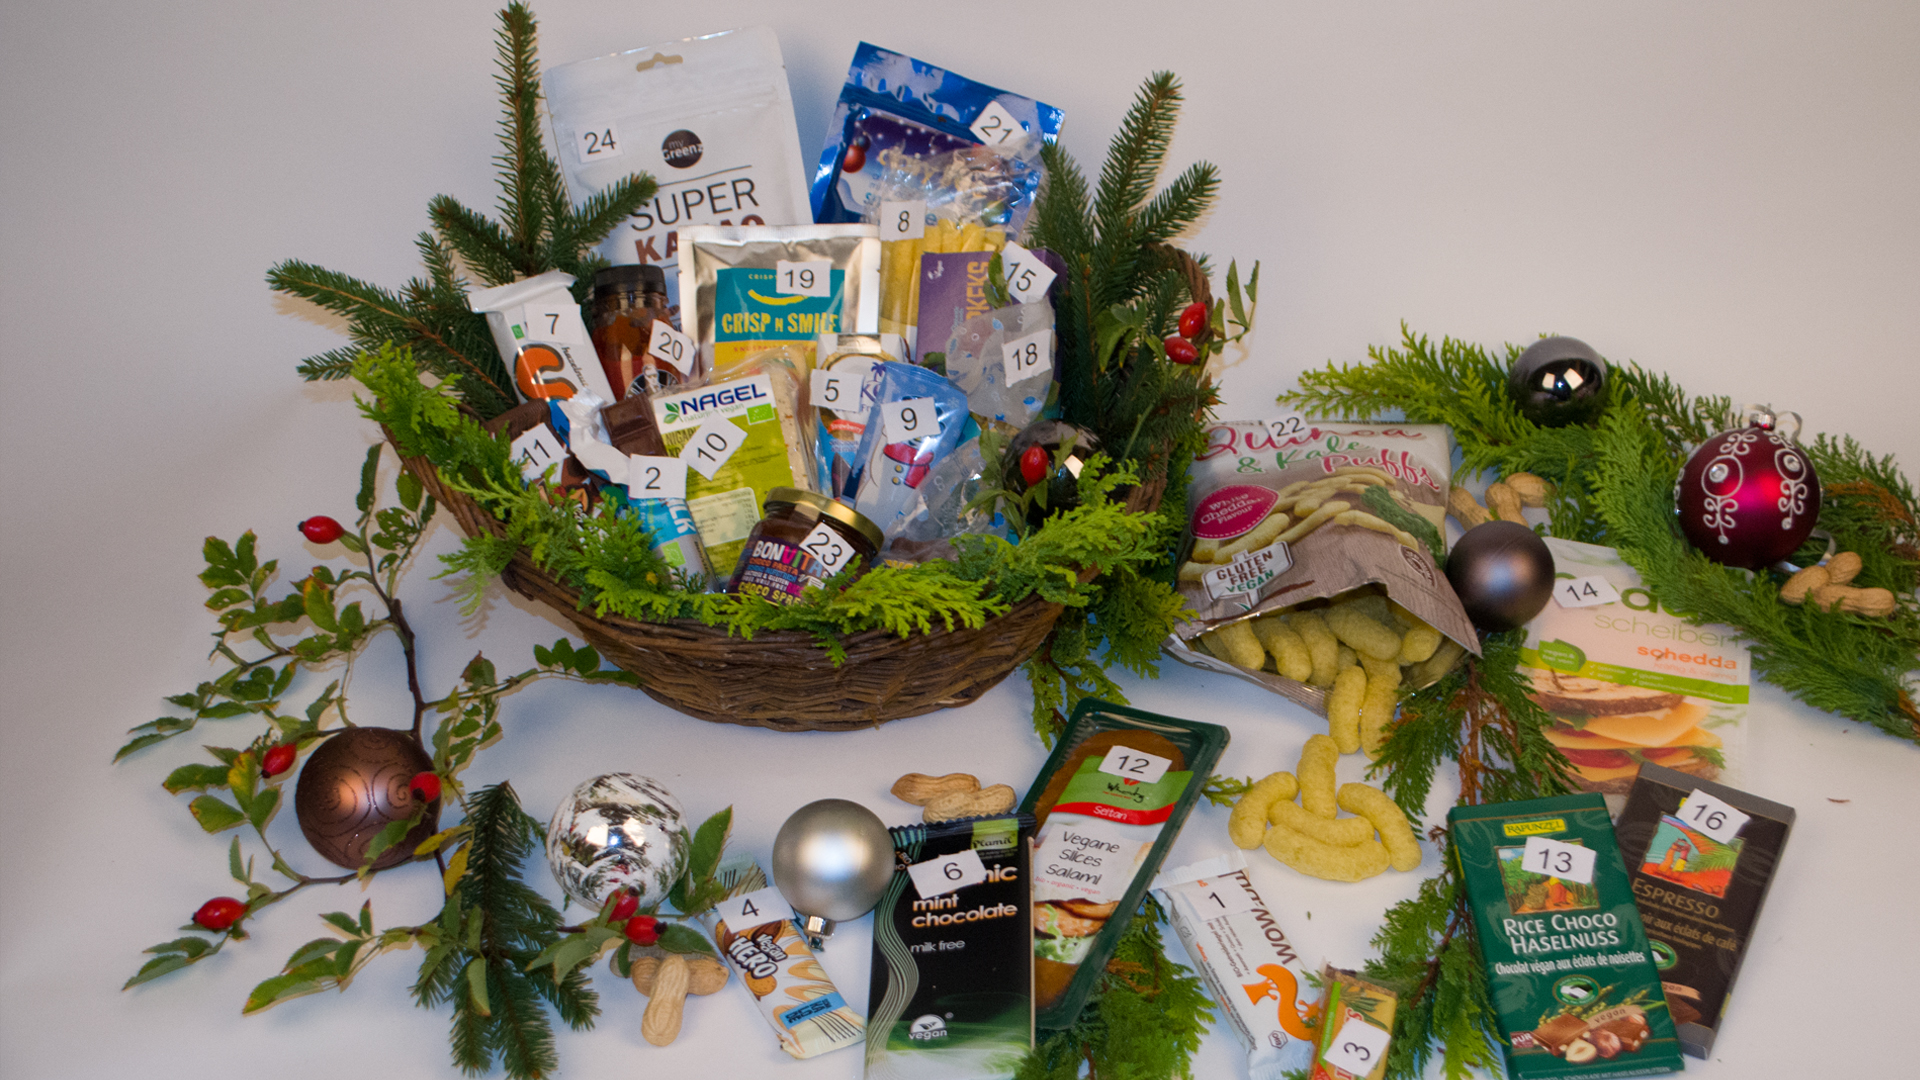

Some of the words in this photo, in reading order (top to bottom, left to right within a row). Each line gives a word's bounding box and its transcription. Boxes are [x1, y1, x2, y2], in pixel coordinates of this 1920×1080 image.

[584, 128, 616, 154] 24
[981, 115, 1013, 144] 21
[631, 177, 759, 231] SUPER
[898, 210, 910, 233] 8
[784, 269, 815, 289] 19
[1007, 262, 1037, 291] 15
[545, 313, 559, 335] 7
[722, 313, 771, 334] CRISP
[775, 317, 784, 333] N
[787, 312, 839, 334] SMILE
[658, 332, 683, 361] 20
[1012, 342, 1038, 370] 18
[681, 384, 767, 415] NAGEL
[824, 379, 840, 402] 5
[901, 407, 918, 431] 9
[1271, 416, 1305, 438] 22
[522, 439, 550, 467] 11
[697, 432, 728, 462] 10
[1236, 456, 1263, 474] &
[1276, 436, 1370, 471] Kale
[644, 467, 661, 490] 2
[1322, 448, 1441, 492] Puffs
[1209, 492, 1249, 512] White
[667, 499, 697, 534] ILK
[806, 531, 842, 566] 23
[1216, 550, 1274, 581] GLUTEN
[1229, 562, 1267, 586] FREE
[1225, 569, 1275, 593] VEGAN
[1567, 581, 1598, 602] 14
[772, 589, 802, 606] SPRE
[1637, 645, 1737, 670] schedda
[1118, 755, 1149, 774] 12
[1093, 805, 1127, 820] Seitan
[1693, 804, 1728, 831] 16
[1505, 820, 1564, 836] RAPUNZEL
[1063, 831, 1120, 854] Vegane
[1059, 849, 1102, 867] Slices
[1538, 848, 1573, 873] 13
[943, 862, 963, 881] 6
[986, 863, 1018, 883] nic
[1046, 864, 1102, 886] Salami
[742, 898, 760, 917] 4
[912, 893, 959, 911] mint
[1209, 892, 1226, 909] 1
[1632, 877, 1720, 920] ESPRESSO
[912, 902, 1018, 928] chocolate
[1503, 918, 1546, 937] RICE
[1551, 913, 1617, 932] CHOCO
[910, 942, 936, 953] milk
[938, 939, 965, 951] free
[1510, 930, 1620, 955] HASELNUSS
[1653, 918, 1673, 931] aux
[1673, 922, 1701, 940] éclats
[1702, 931, 1715, 945] de
[1716, 937, 1737, 952] café
[729, 936, 779, 978] HERO
[1495, 957, 1530, 975] Chocolat
[1530, 955, 1555, 975] végan
[1556, 956, 1572, 971] aux
[1572, 953, 1596, 970] éclats
[1596, 951, 1608, 966] de
[1608, 949, 1646, 966] noisettes
[908, 1029, 948, 1041] vegan
[1512, 1032, 1532, 1045] PUR
[1344, 1042, 1371, 1061] 3
